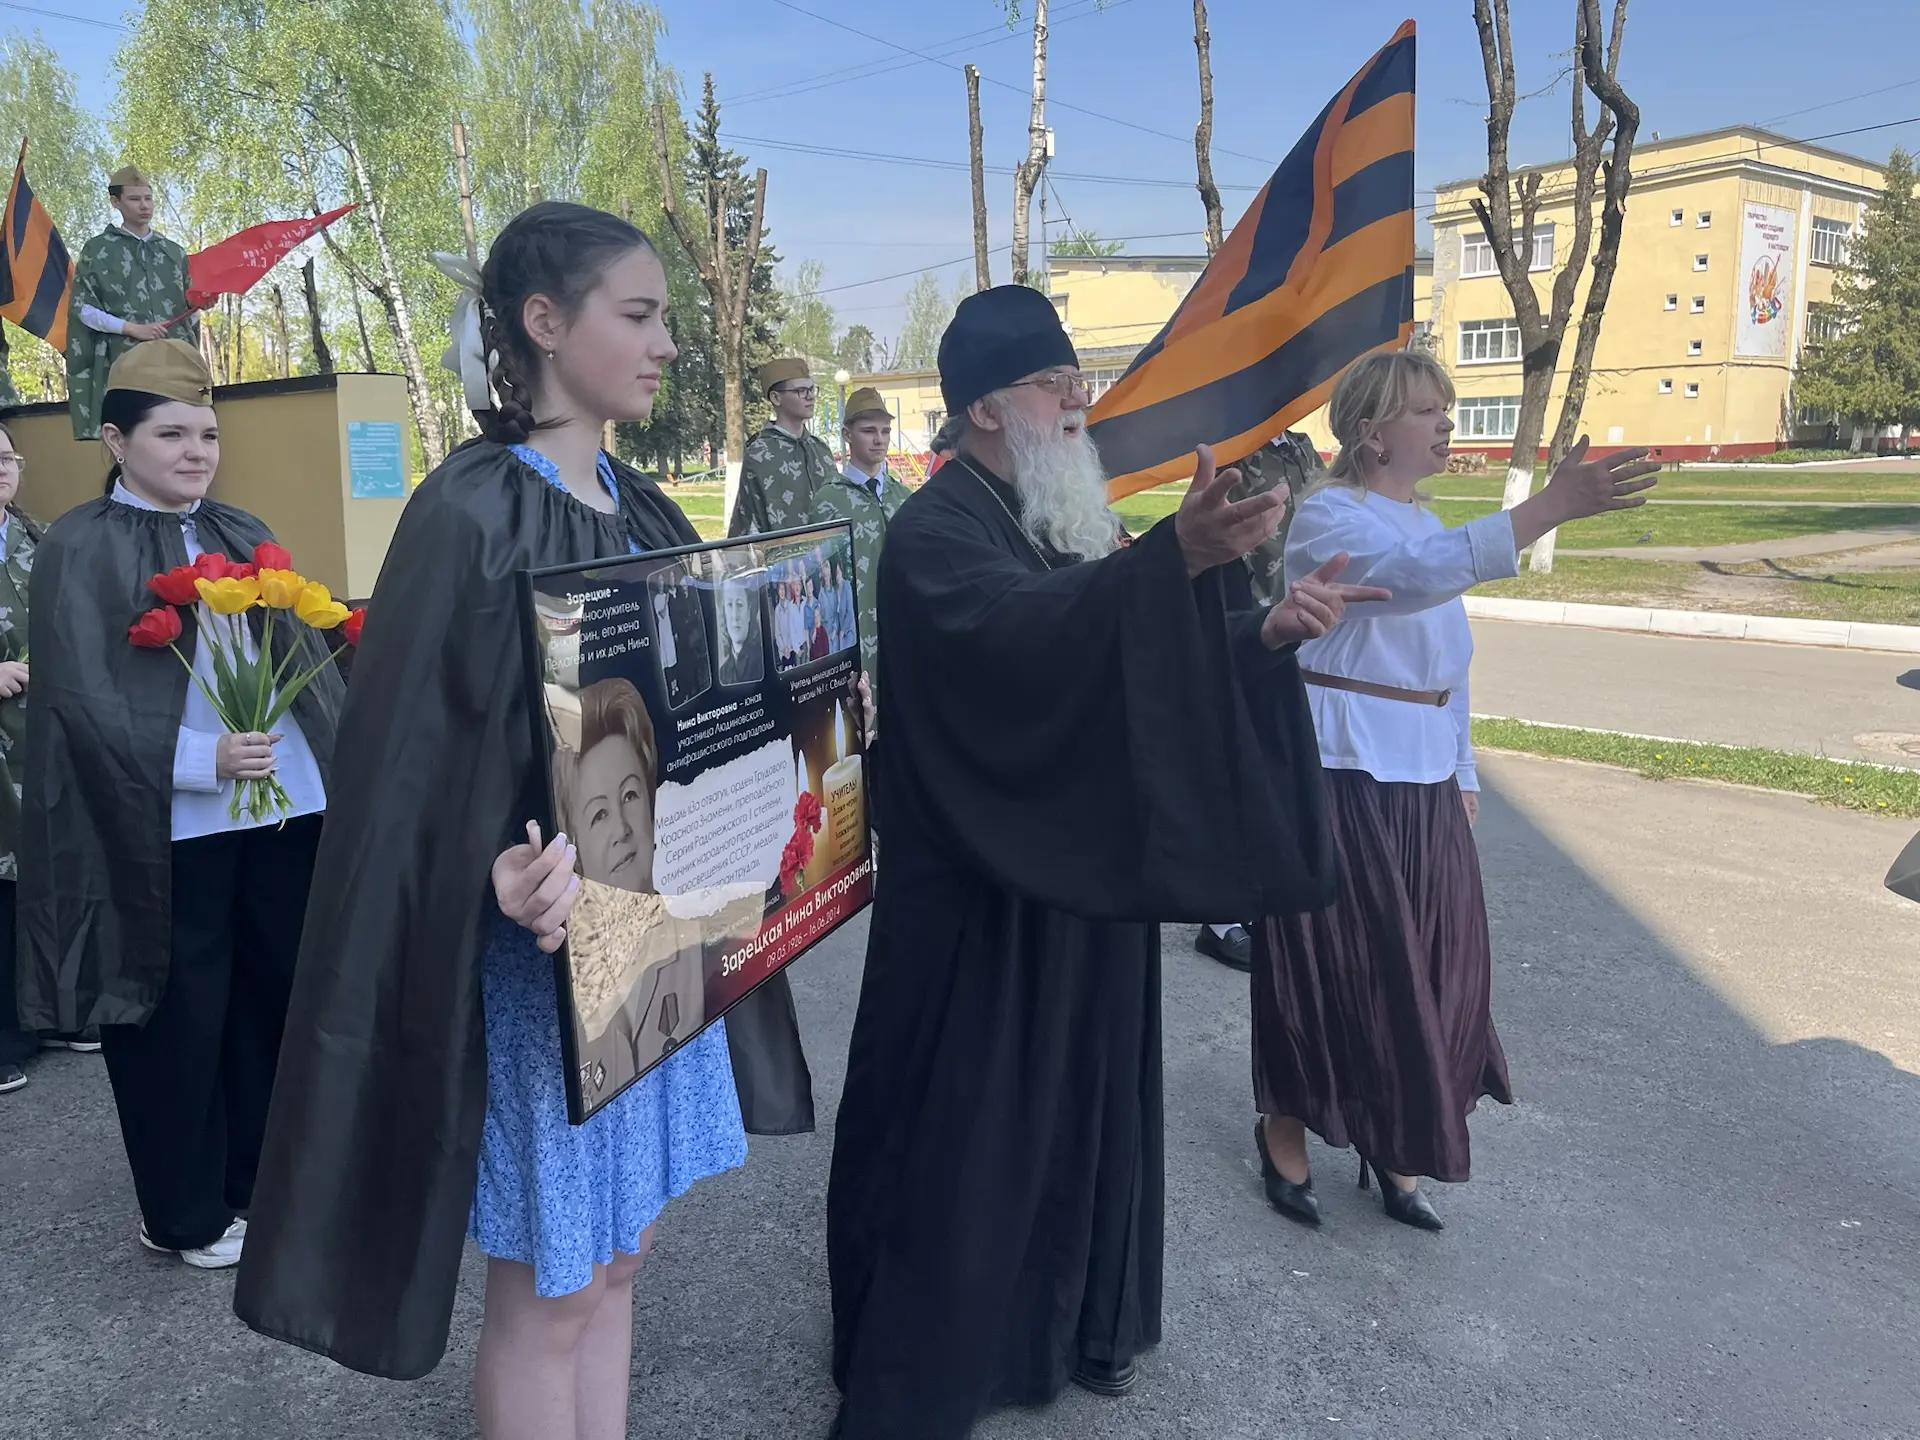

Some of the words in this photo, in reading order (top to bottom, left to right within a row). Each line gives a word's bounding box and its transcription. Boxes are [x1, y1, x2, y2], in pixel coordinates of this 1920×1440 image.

[566, 588, 611, 605] Зарецкие
[545, 653, 585, 670] Пелагея
[587, 652, 594, 662] и
[595, 649, 606, 659] их
[608, 643, 626, 658] дочь
[627, 636, 649, 651] Нина
[551, 631, 600, 649] Викторин,
[601, 626, 616, 638] его
[617, 620, 640, 633] жена
[790, 676, 811, 691] Учитель
[811, 666, 839, 683] немецкого
[676, 717, 696, 732] Нина
[696, 702, 738, 725] Викторовна
[744, 693, 762, 707] юная
[677, 727, 714, 752] участница
[715, 708, 765, 734] Людиновского
[666, 737, 733, 773] антифашистского
[655, 808, 687, 831] Медаль
[730, 777, 753, 794] орден
[754, 759, 788, 783] Трудового
[660, 822, 699, 848] Красного
[735, 777, 785, 807] преподобного
[661, 861, 696, 886] отличник
[696, 836, 736, 866] народного
[736, 813, 784, 843] просвещения
[665, 842, 694, 865] Сергия
[695, 813, 748, 847] Радонежского
[677, 858, 728, 896] просвещения
[729, 843, 753, 865] СССР,
[753, 831, 779, 850] медаль
[721, 922, 782, 977] Зарецкая
[785, 901, 813, 933] Нина
[814, 858, 871, 910] Викторовна
[766, 933, 803, 968] 09.05.1926
[809, 905, 841, 936] 16.06.2014
